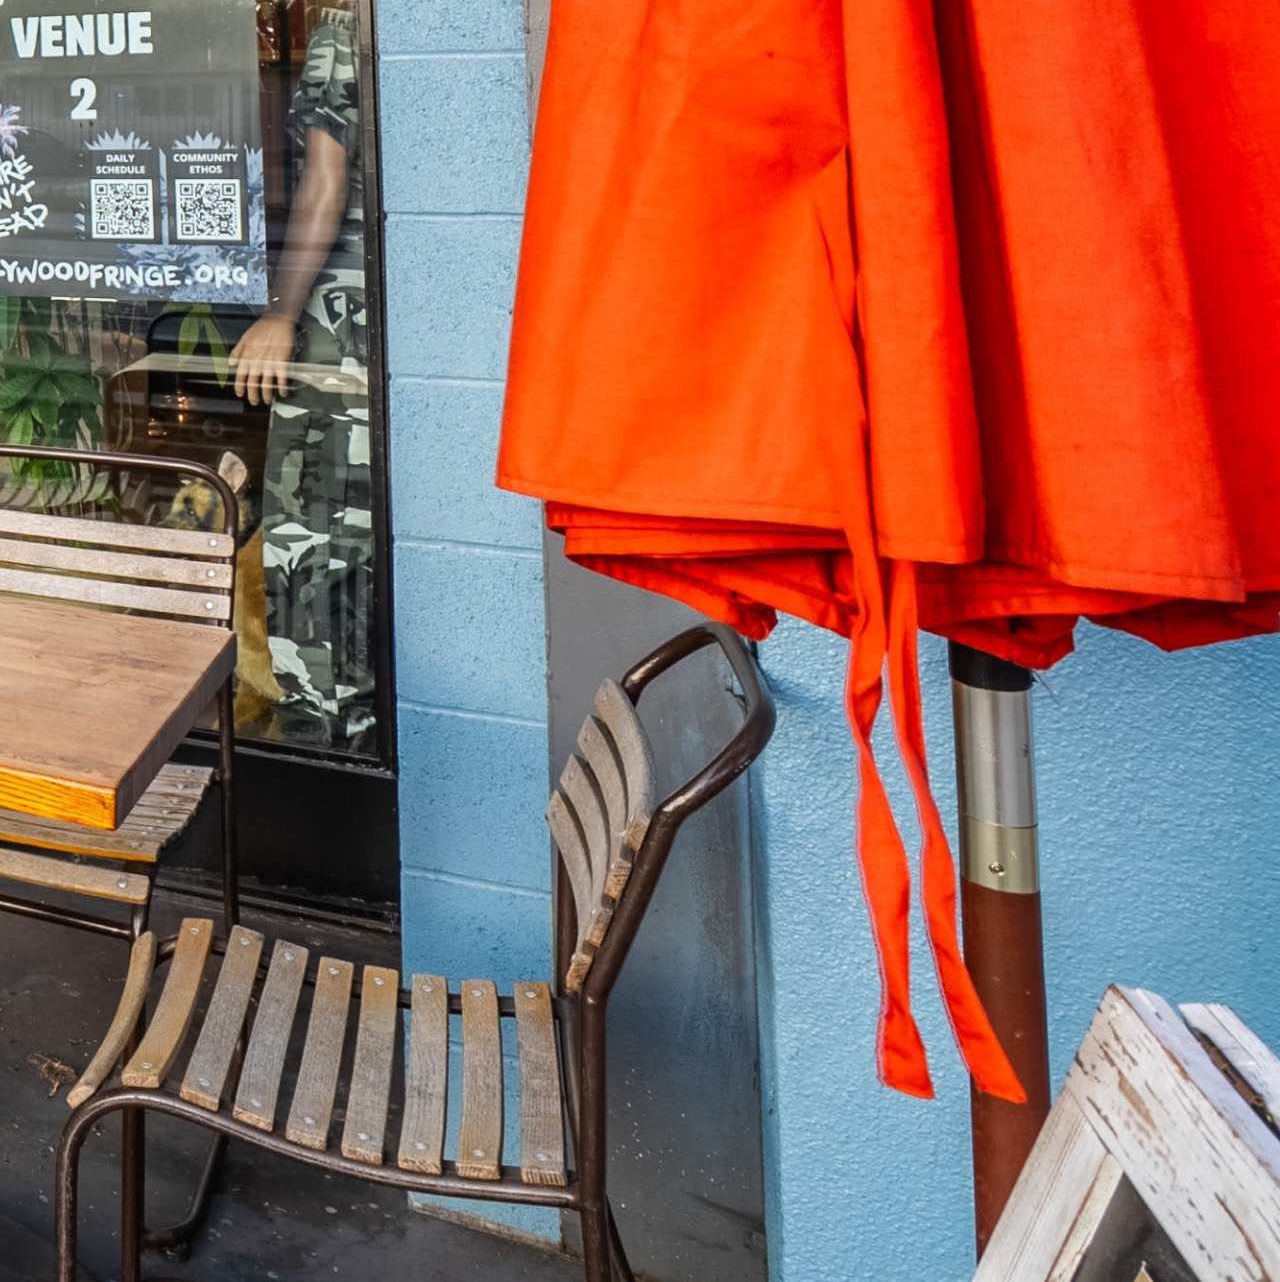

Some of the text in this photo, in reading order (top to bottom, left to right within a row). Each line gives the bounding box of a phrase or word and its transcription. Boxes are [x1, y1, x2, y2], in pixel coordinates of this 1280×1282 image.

[12, 11, 153, 59] VENUE
[70, 77, 97, 121] 2
[106, 154, 135, 164] DAILY
[173, 153, 239, 164] COMMUNITY
[96, 165, 146, 175] SCHEDULE
[189, 164, 223, 174] ETHOS
